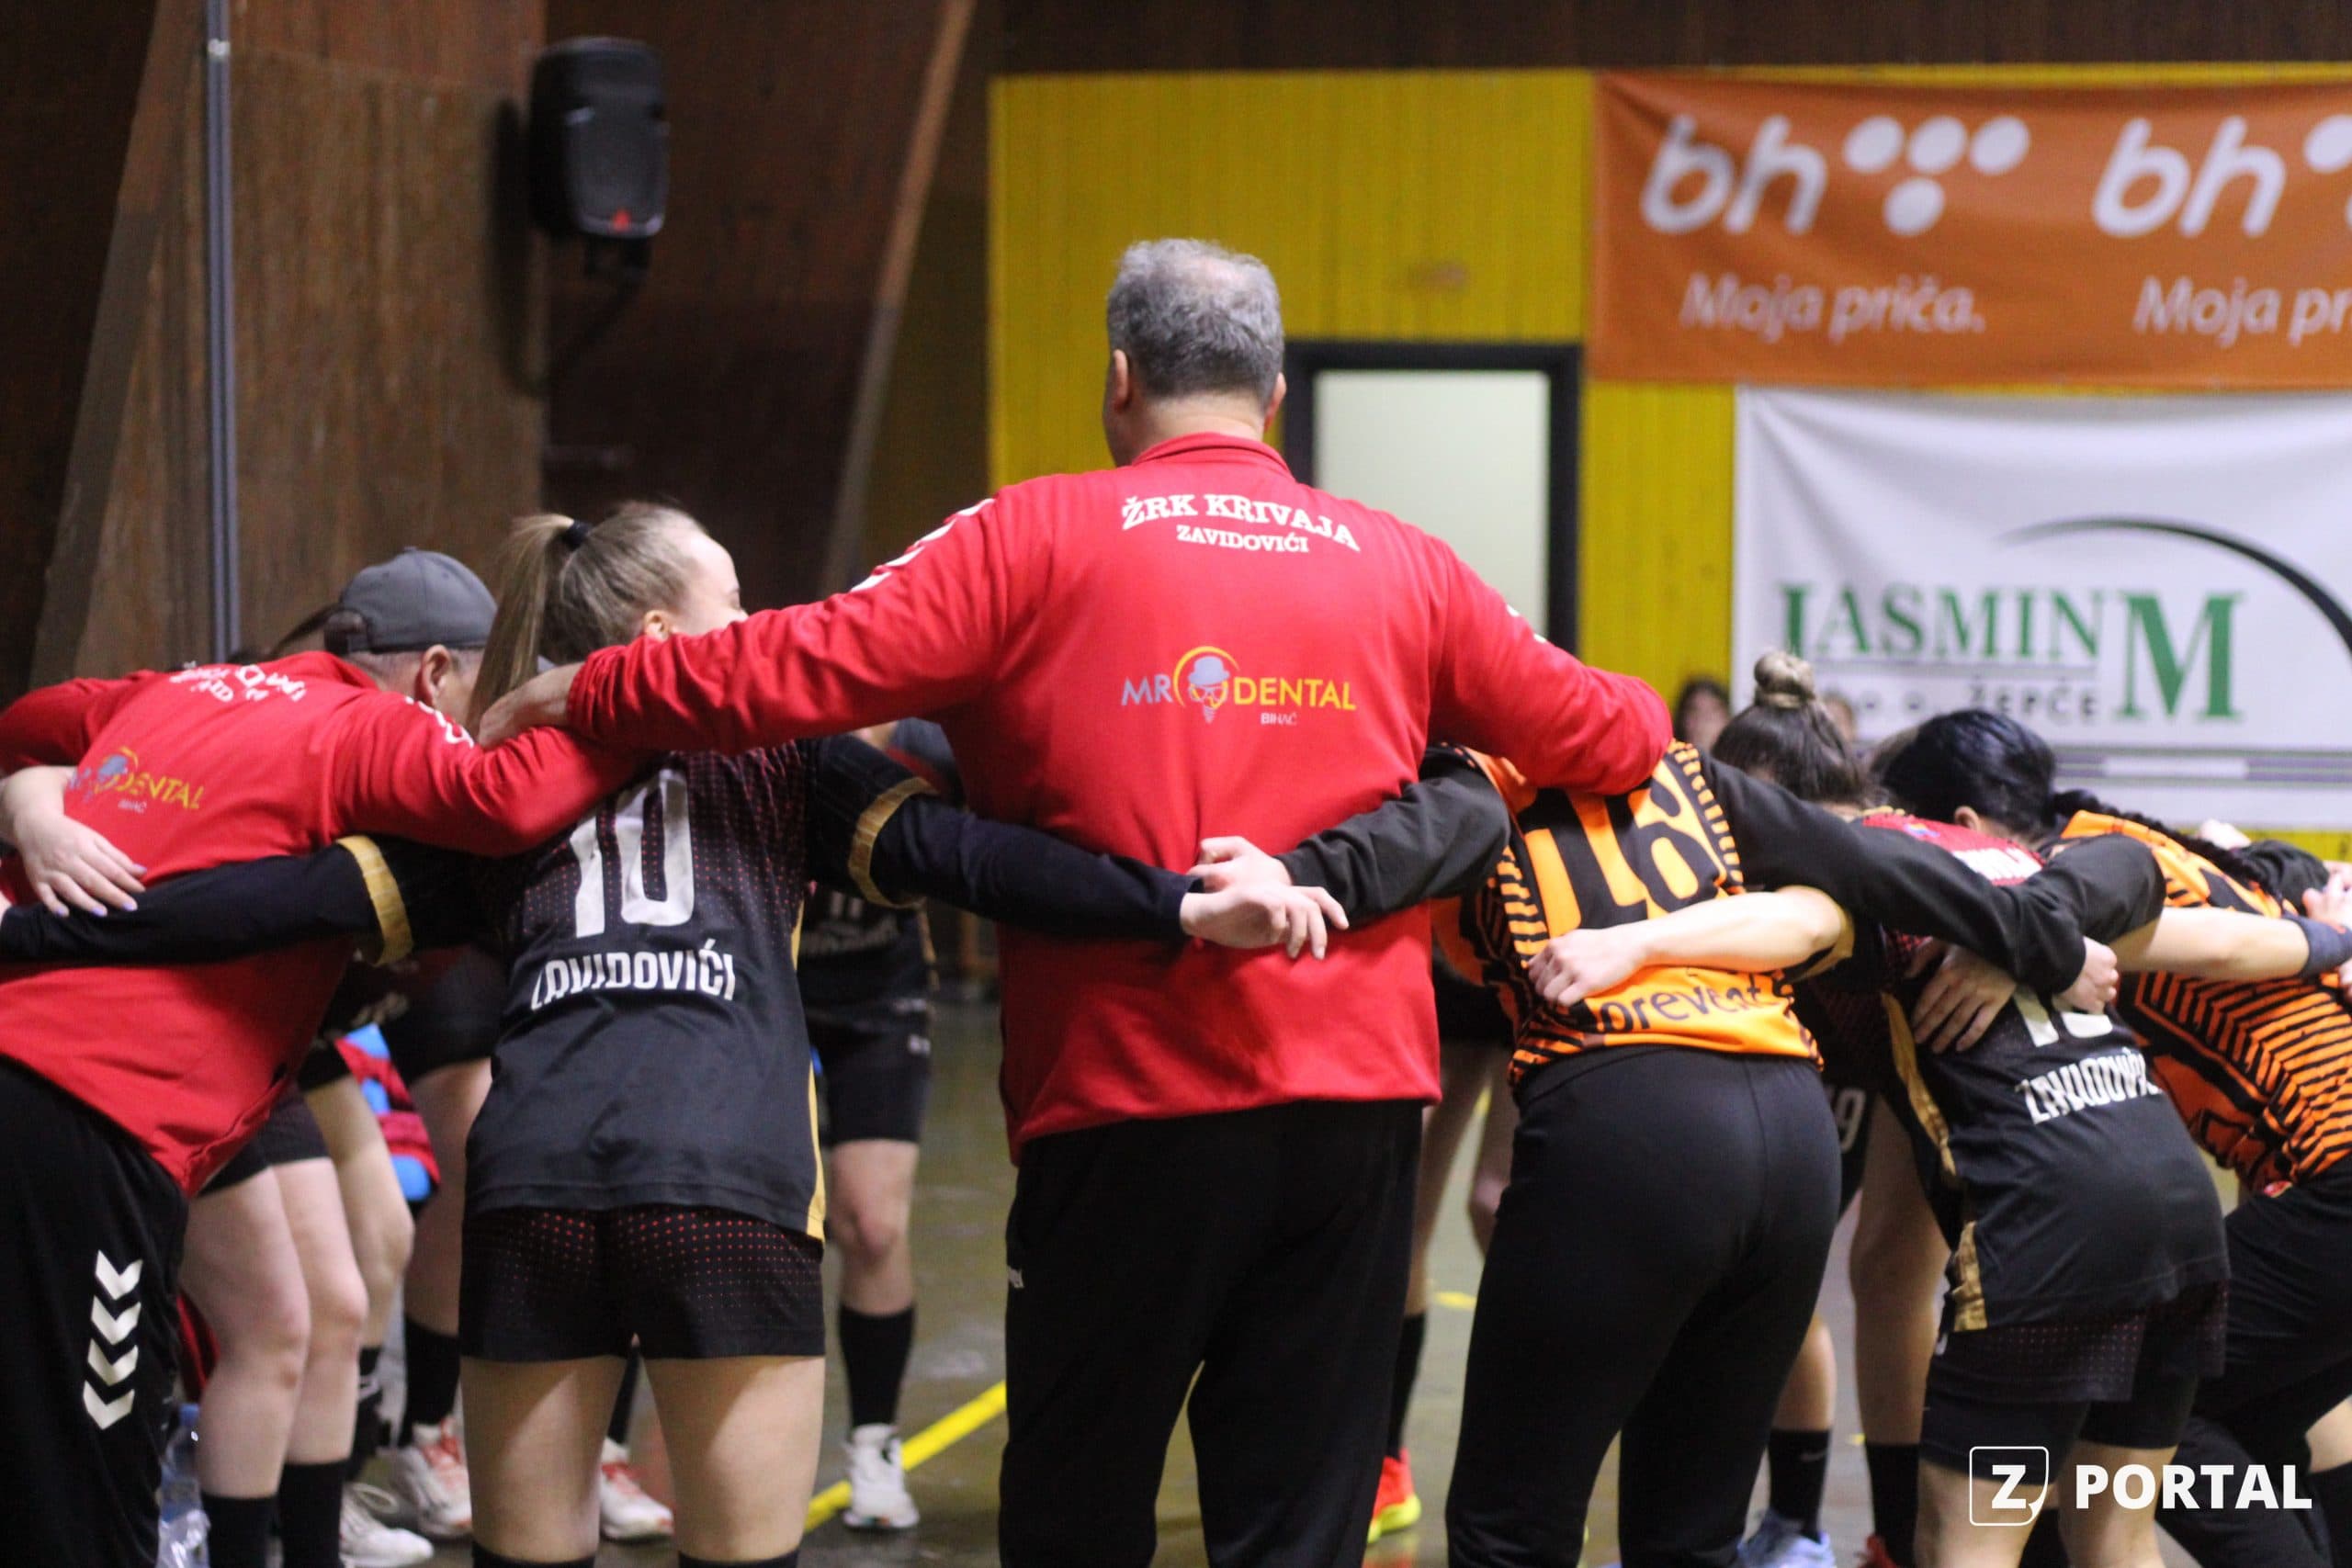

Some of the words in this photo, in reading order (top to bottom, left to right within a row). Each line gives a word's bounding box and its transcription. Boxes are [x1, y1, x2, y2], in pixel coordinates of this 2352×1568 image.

[1679, 273, 1821, 344] Moja
[1828, 275, 1987, 344] priča.
[2132, 275, 2280, 348] Moja
[1121, 494, 1197, 531] ŽRK
[1204, 493, 1361, 552] KRIVAJA
[1176, 525, 1310, 553] ZAVIDOVIĆI
[2116, 590, 2245, 720] M
[1121, 672, 1174, 706] MR
[1233, 677, 1357, 710] DENTAL
[569, 768, 695, 939] 10
